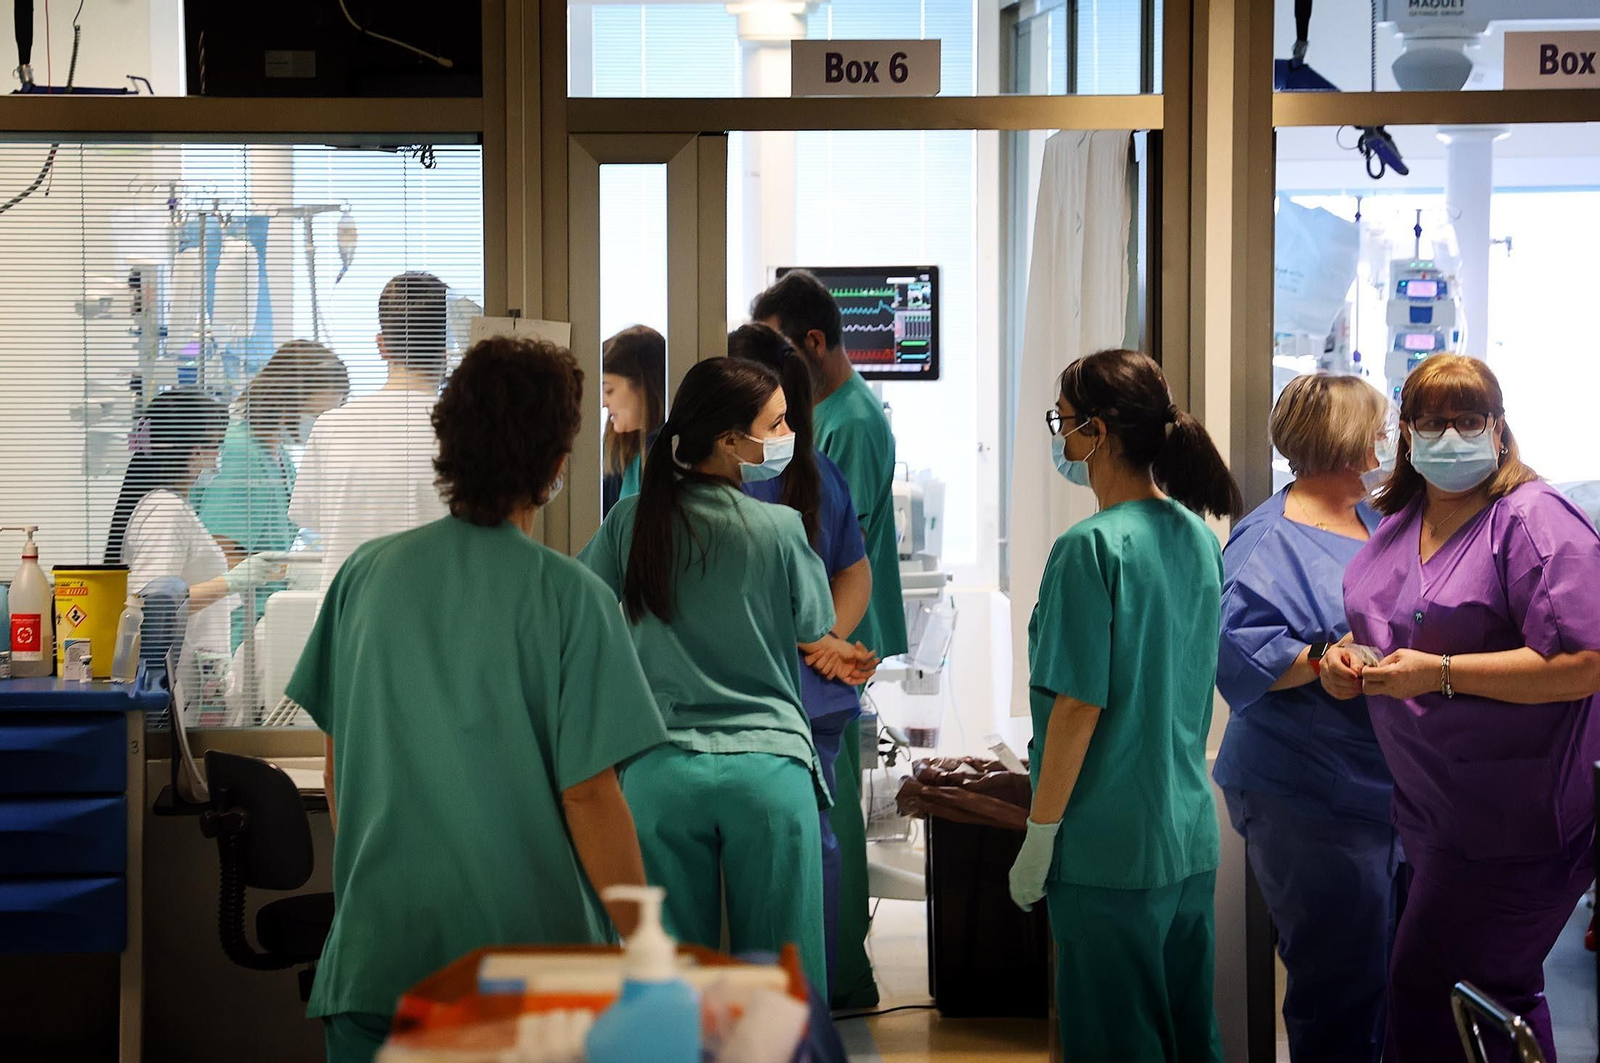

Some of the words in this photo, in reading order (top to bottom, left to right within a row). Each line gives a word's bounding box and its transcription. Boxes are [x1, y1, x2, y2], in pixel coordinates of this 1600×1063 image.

[825, 52, 879, 83] Box
[889, 52, 909, 82] 6
[1540, 44, 1596, 76] Box
